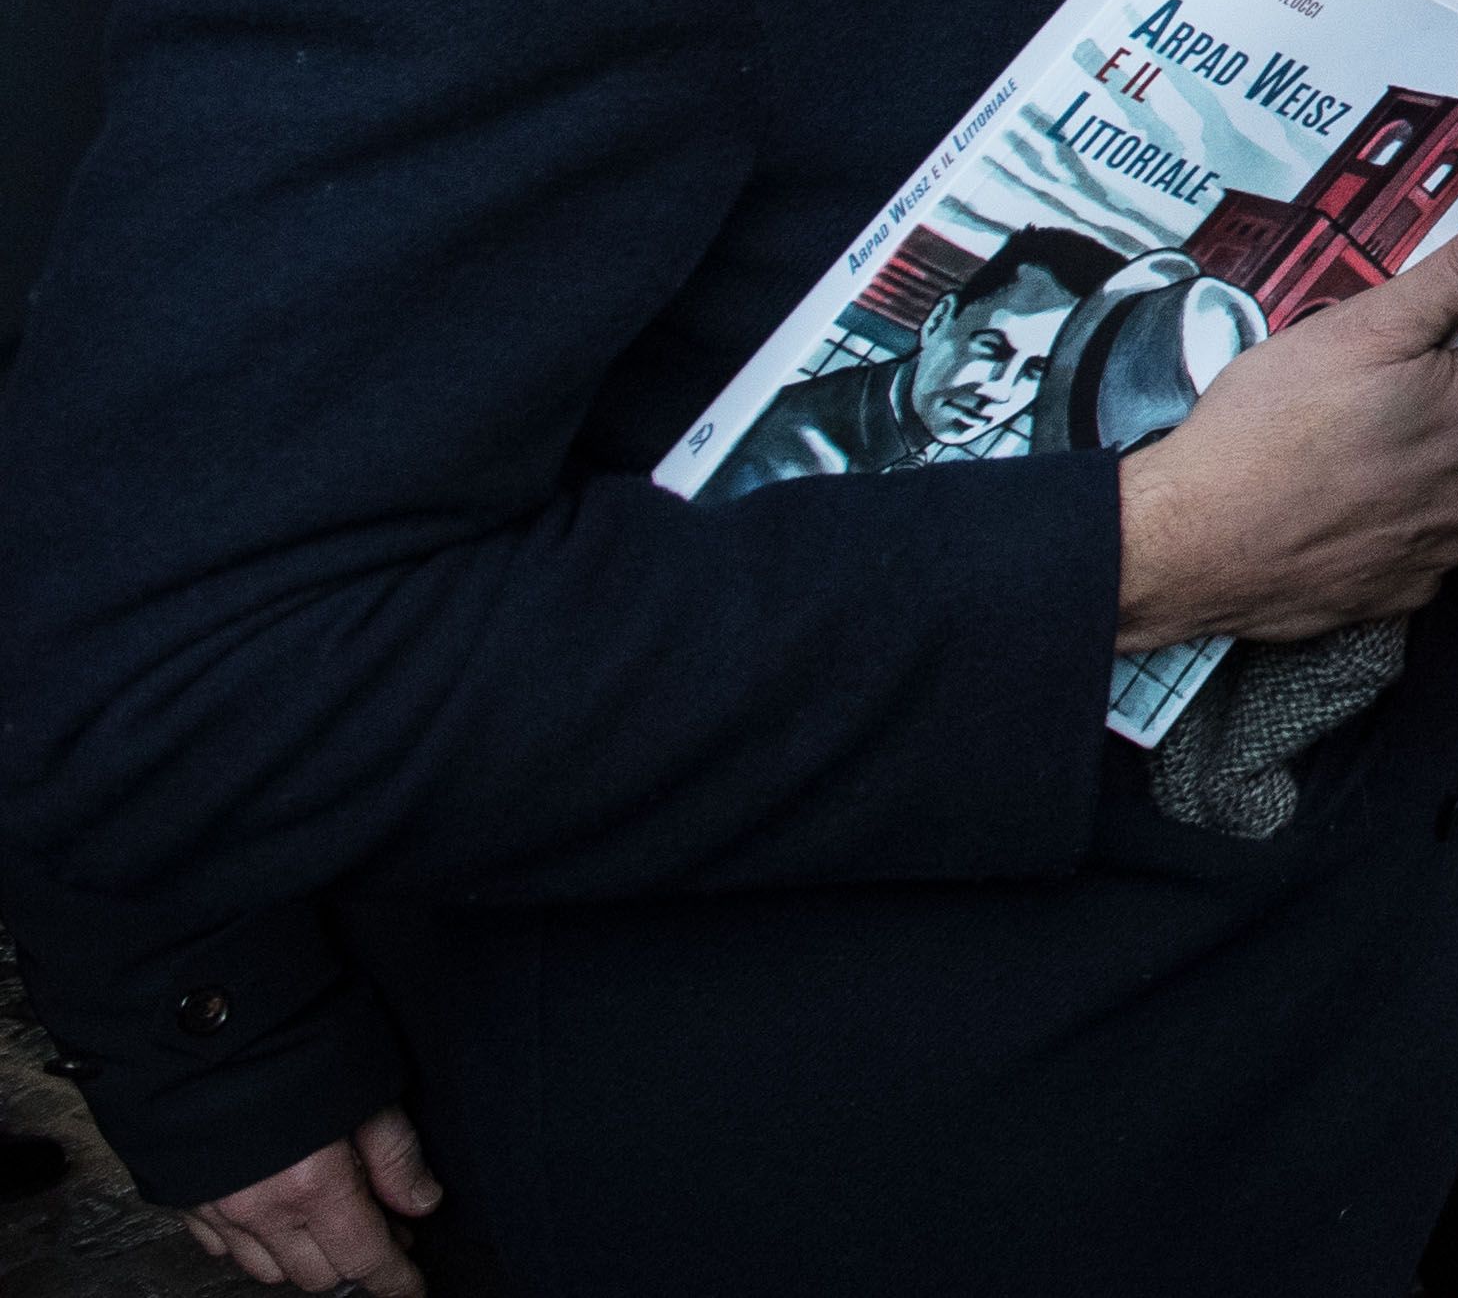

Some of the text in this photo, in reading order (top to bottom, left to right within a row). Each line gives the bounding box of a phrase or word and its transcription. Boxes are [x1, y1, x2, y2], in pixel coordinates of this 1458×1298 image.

[1094, 46, 1162, 103] E IL
[1244, 51, 1353, 137] WEISZ
[847, 223, 890, 275] ARPAD
[888, 176, 932, 225] WEISZ
[931, 167, 941, 180] E
[952, 77, 1019, 153] LITTORIALE
[1046, 90, 1221, 205] LITTORIALE
